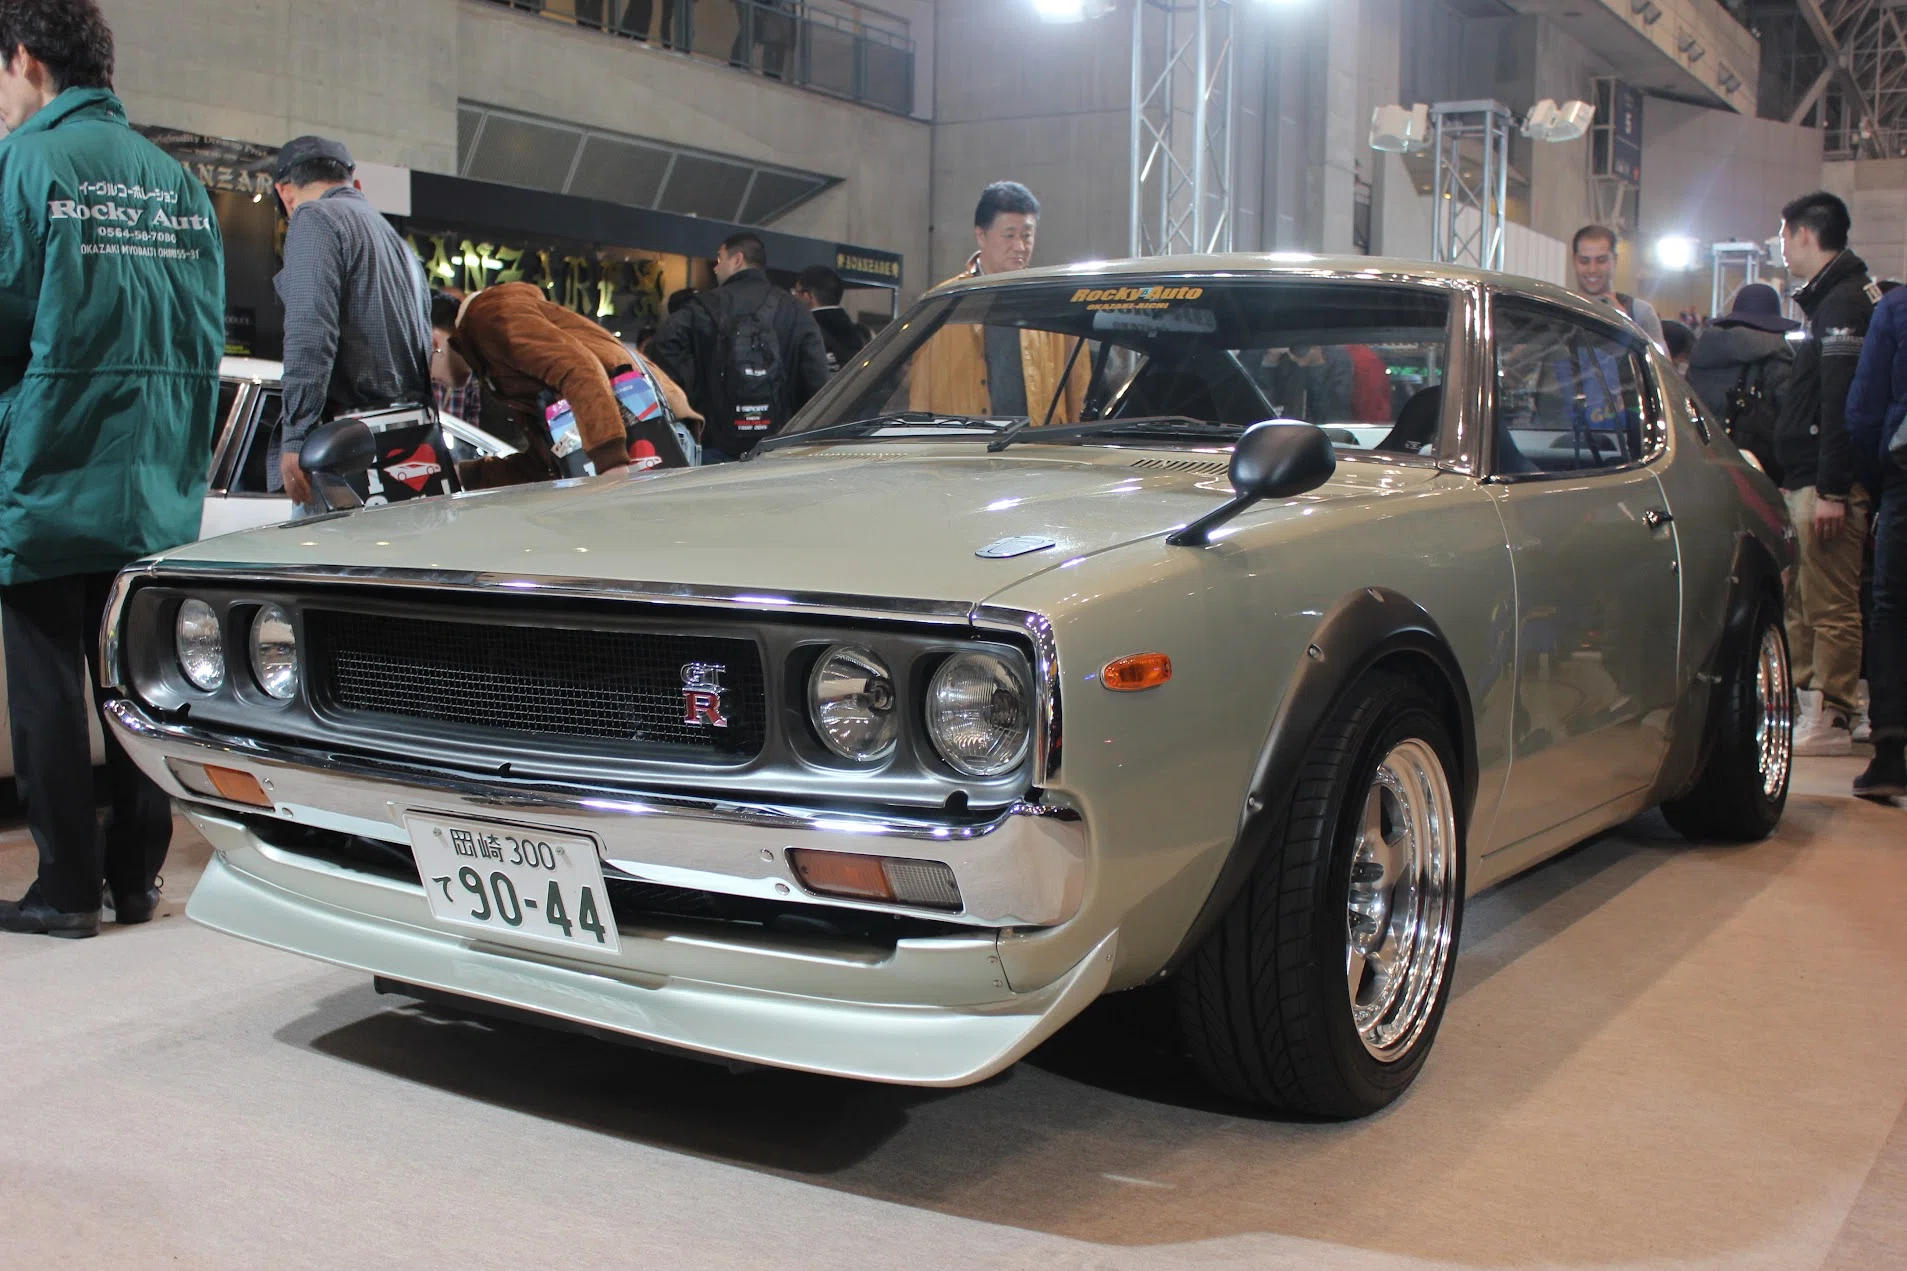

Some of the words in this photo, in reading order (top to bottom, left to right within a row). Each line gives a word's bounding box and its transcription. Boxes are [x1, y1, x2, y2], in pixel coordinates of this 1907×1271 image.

[48, 200, 143, 226] Rocky
[97, 226, 177, 243] 0564-58-7080
[80, 243, 120, 255] OKAZAKI
[1070, 286, 1141, 302] Rocky
[1149, 285, 1203, 300] Auto
[680, 662, 726, 688] GT
[682, 687, 728, 728] R
[432, 875, 454, 903] て
[458, 865, 606, 944] 90-44
